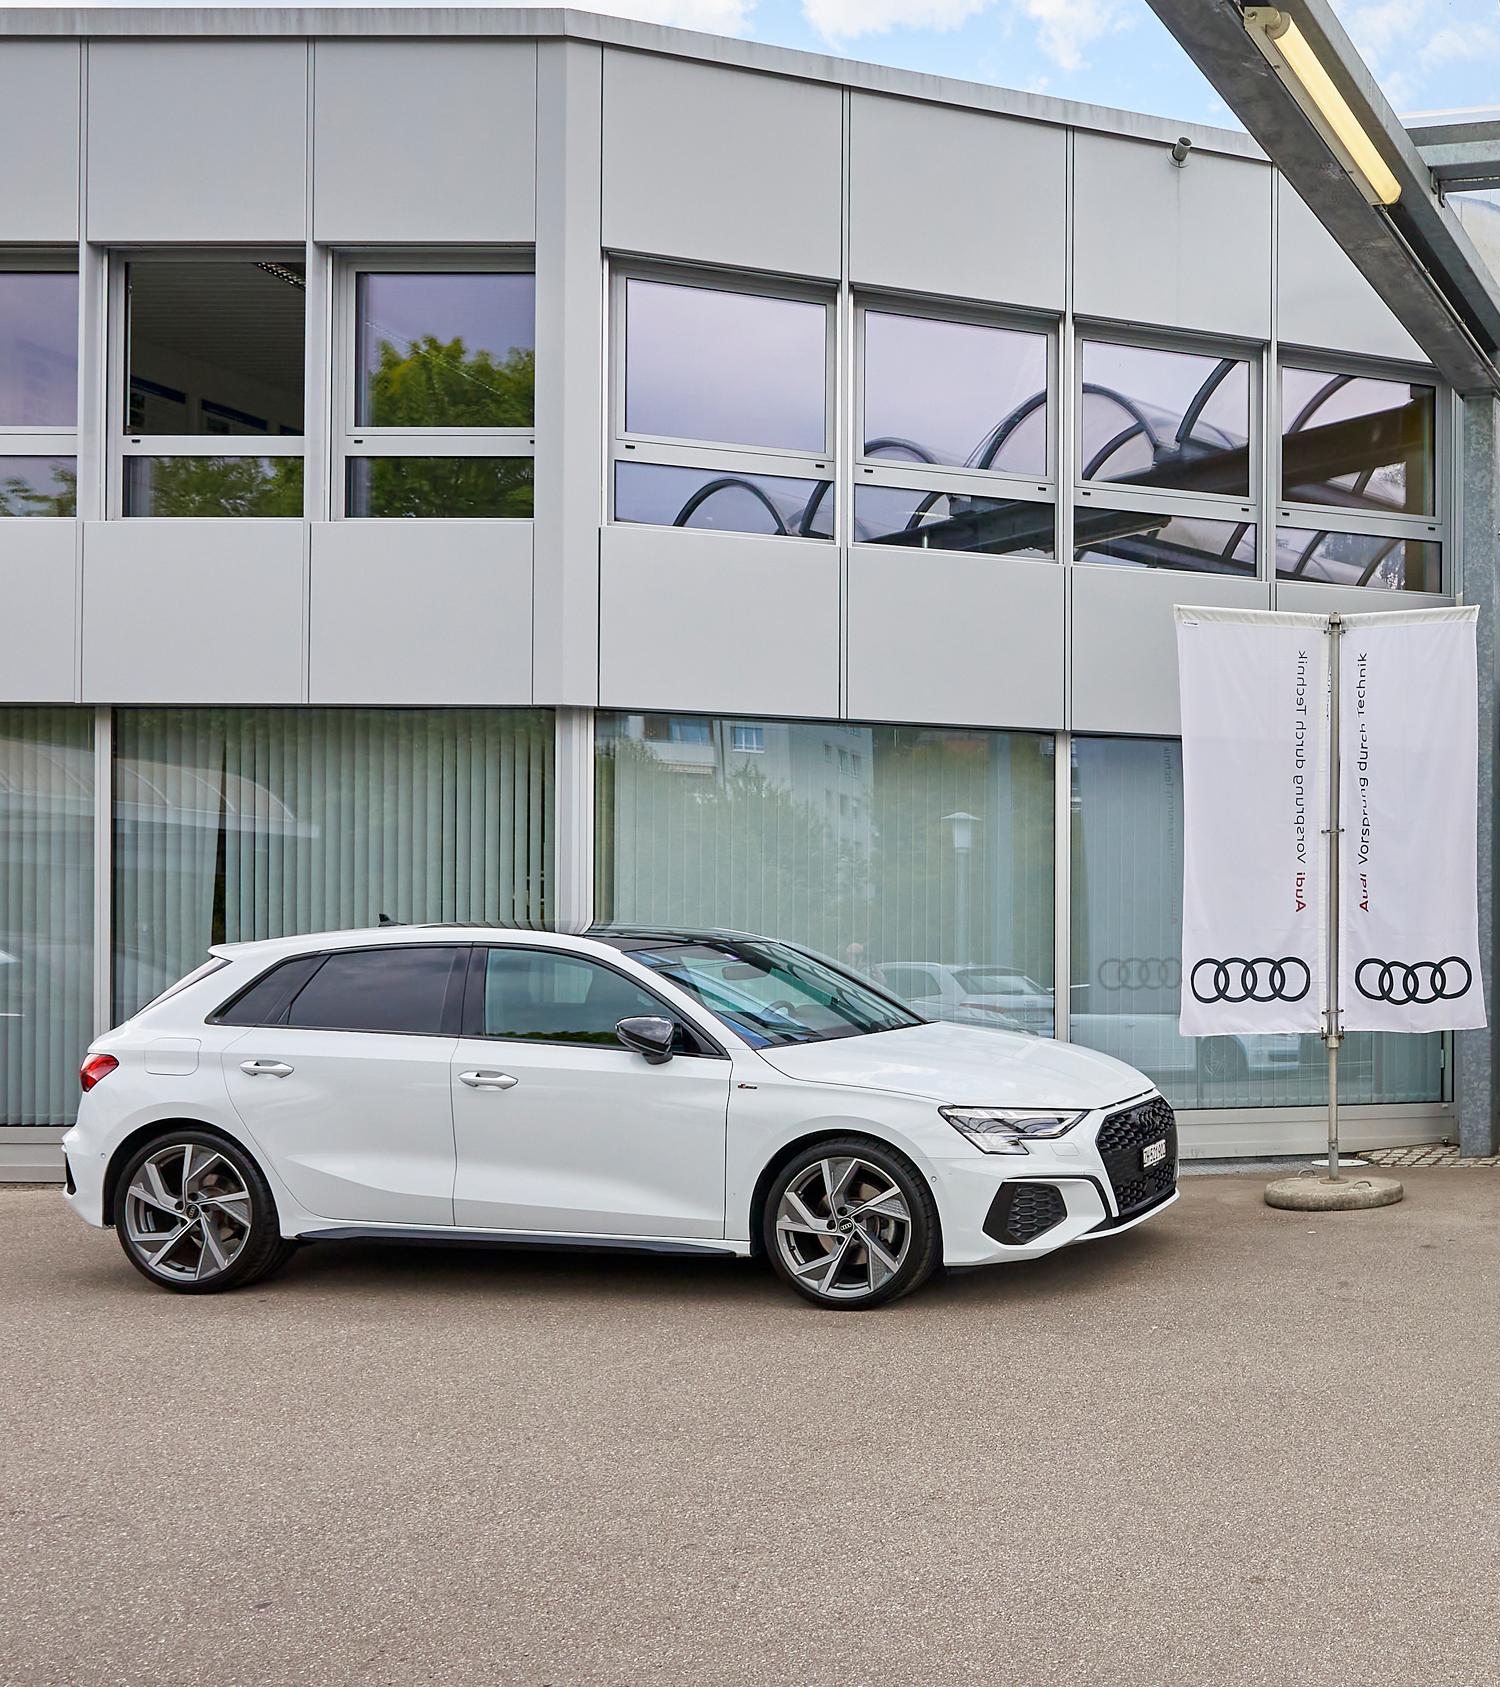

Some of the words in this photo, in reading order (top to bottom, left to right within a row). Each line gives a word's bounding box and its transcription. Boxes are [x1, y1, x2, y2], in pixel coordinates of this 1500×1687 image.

[1356, 652, 1368, 718] Technik
[1357, 724, 1369, 771] durch
[1358, 777, 1370, 865] Vorsprung
[1359, 873, 1369, 912] Audi
